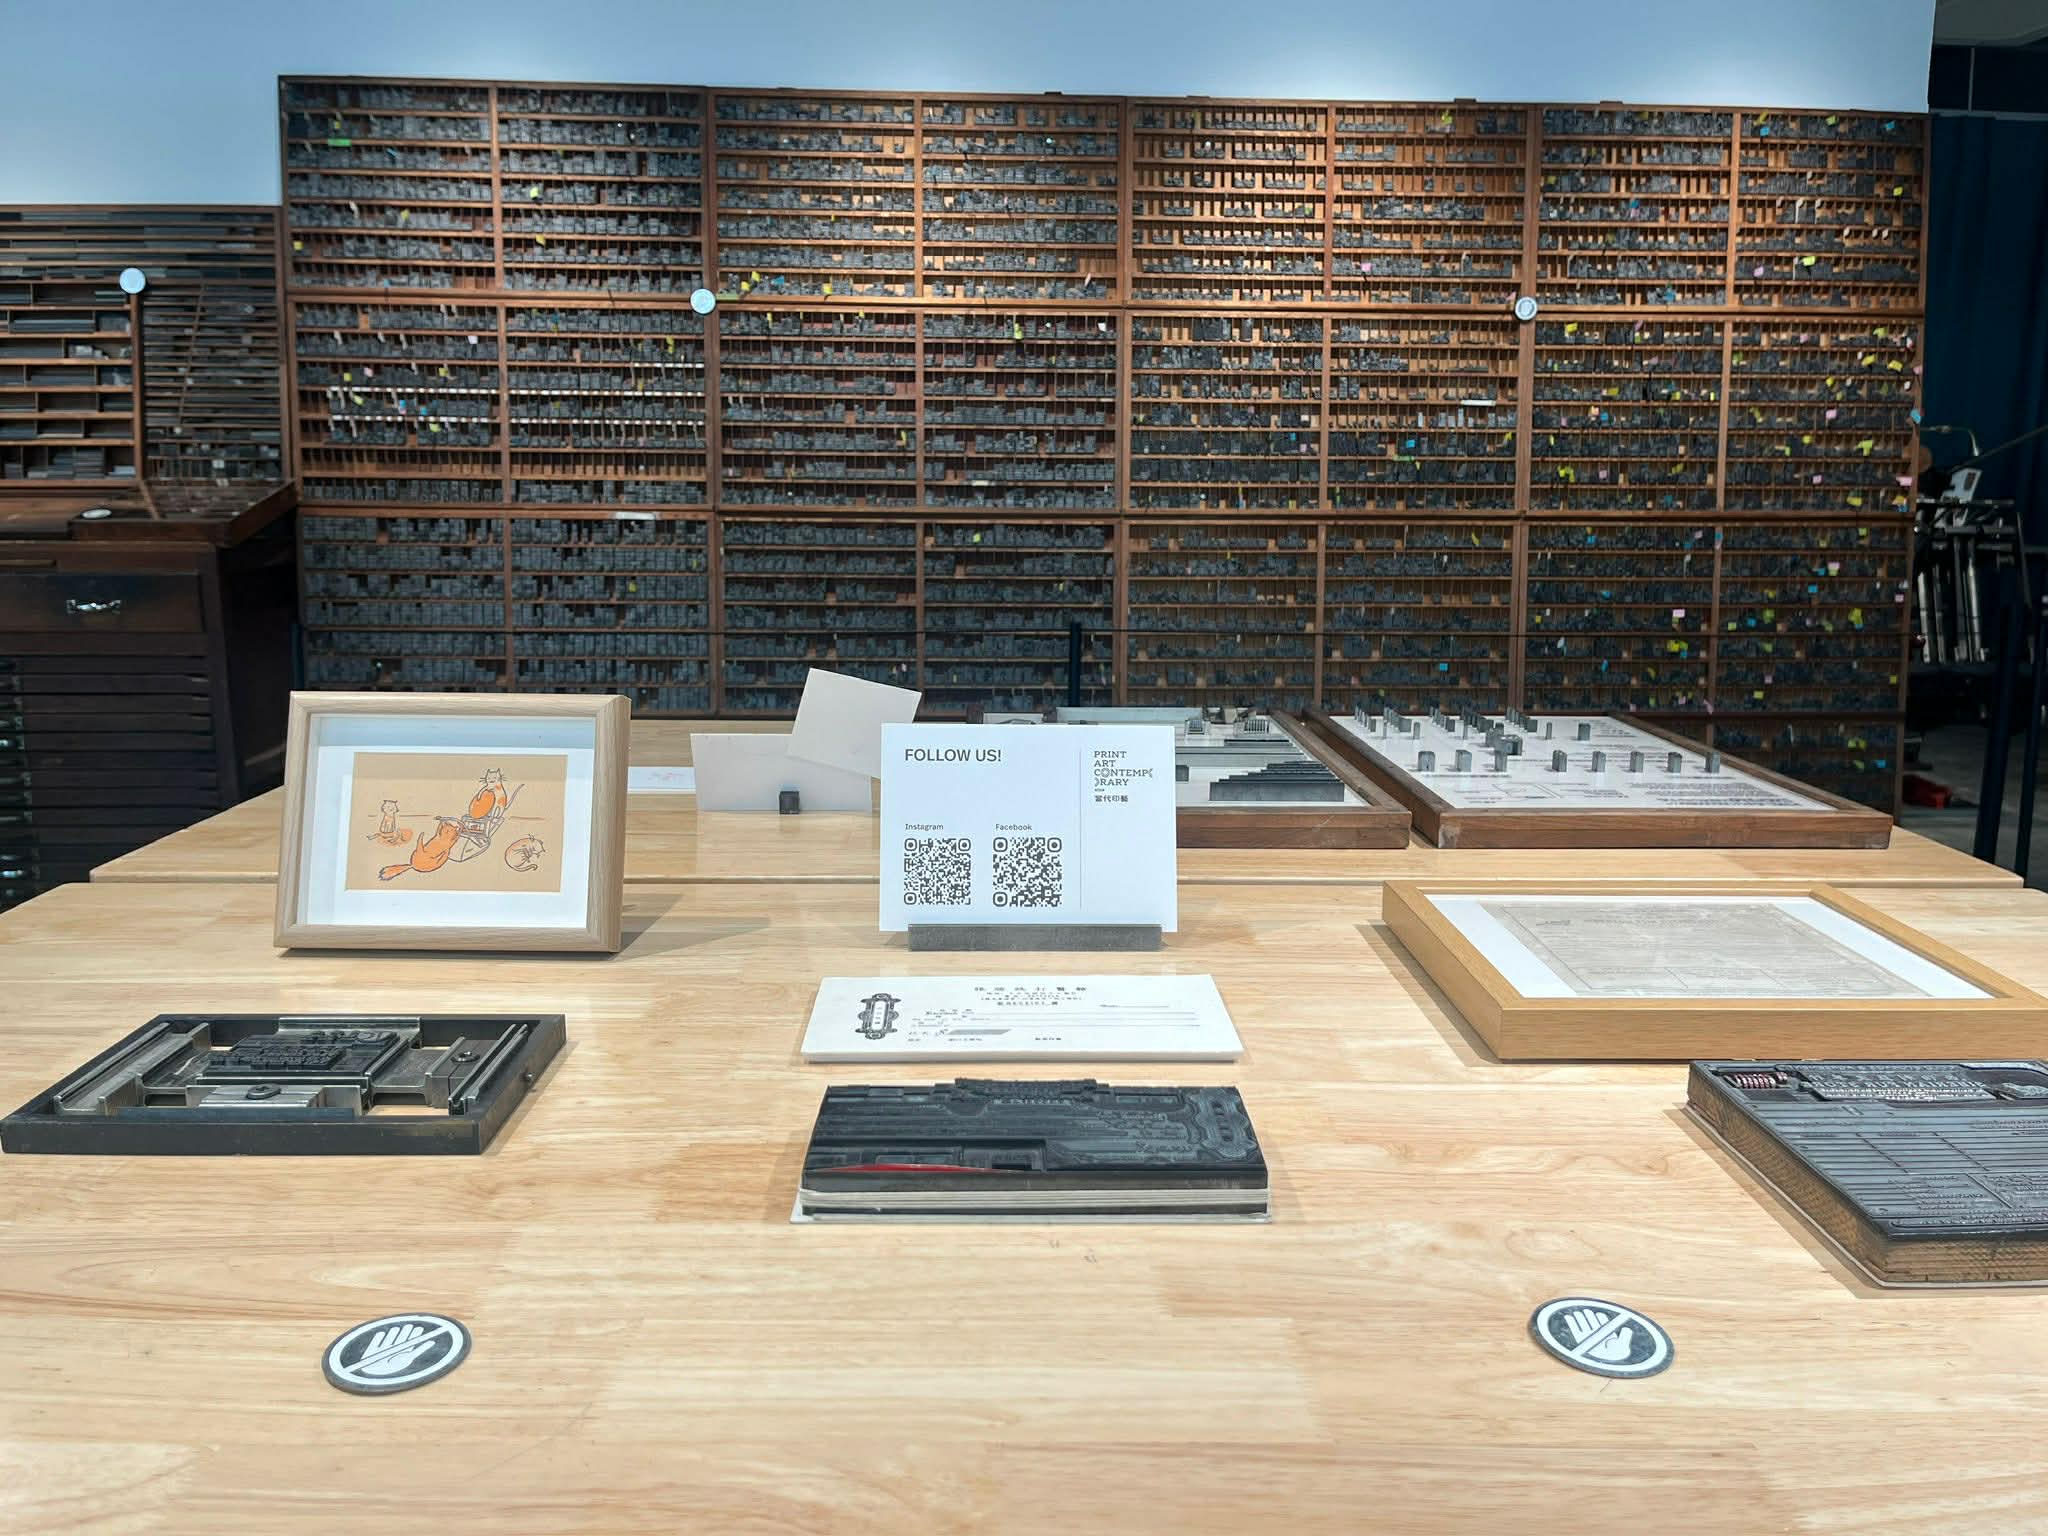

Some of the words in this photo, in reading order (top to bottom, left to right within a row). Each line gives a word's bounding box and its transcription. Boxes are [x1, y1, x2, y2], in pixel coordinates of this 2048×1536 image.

[904, 749, 971, 762] FOLLOW
[975, 749, 1002, 762] US!
[1094, 750, 1127, 759] PRINT
[1094, 759, 1116, 767] ART
[904, 824, 944, 832] Instagram
